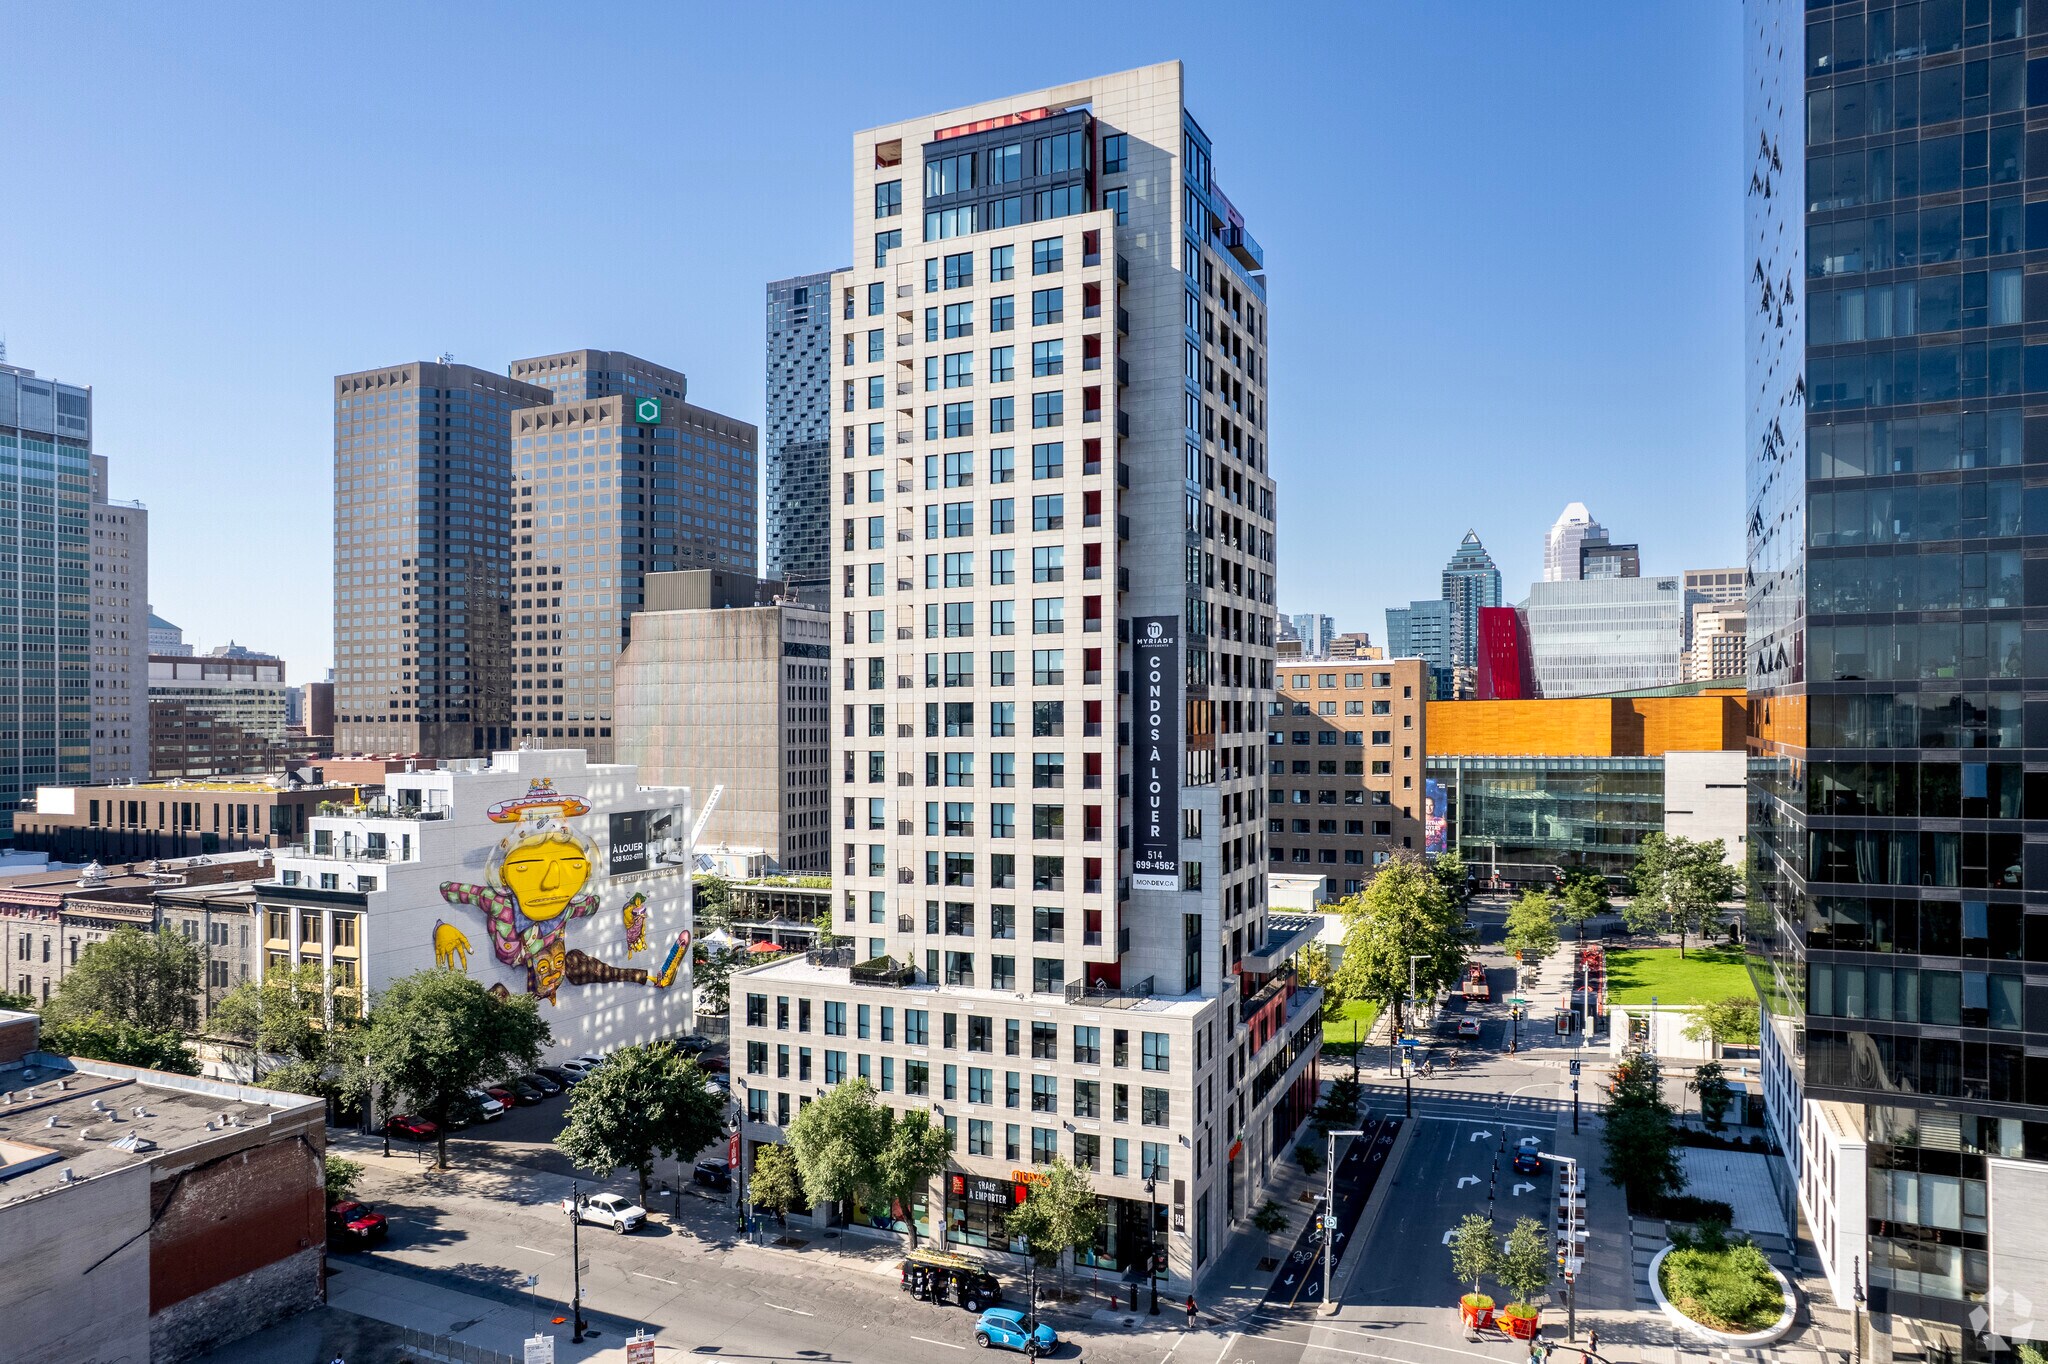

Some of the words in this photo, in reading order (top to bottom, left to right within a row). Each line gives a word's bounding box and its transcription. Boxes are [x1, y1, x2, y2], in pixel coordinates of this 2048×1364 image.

[1150, 656, 1161, 740] CONDOS
[1150, 746, 1160, 761] À
[1150, 768, 1161, 837] LOUER
[613, 844, 619, 854] À
[619, 842, 643, 852] LOUER
[622, 852, 643, 861] 502-6111
[1148, 850, 1162, 860] 514
[1136, 860, 1174, 870] 699-4562
[617, 868, 678, 883] LEPETITLAURENT.COM
[978, 1181, 996, 1192] FRAIS
[969, 1188, 973, 1199] À
[976, 1191, 1007, 1204] EMPORTER
